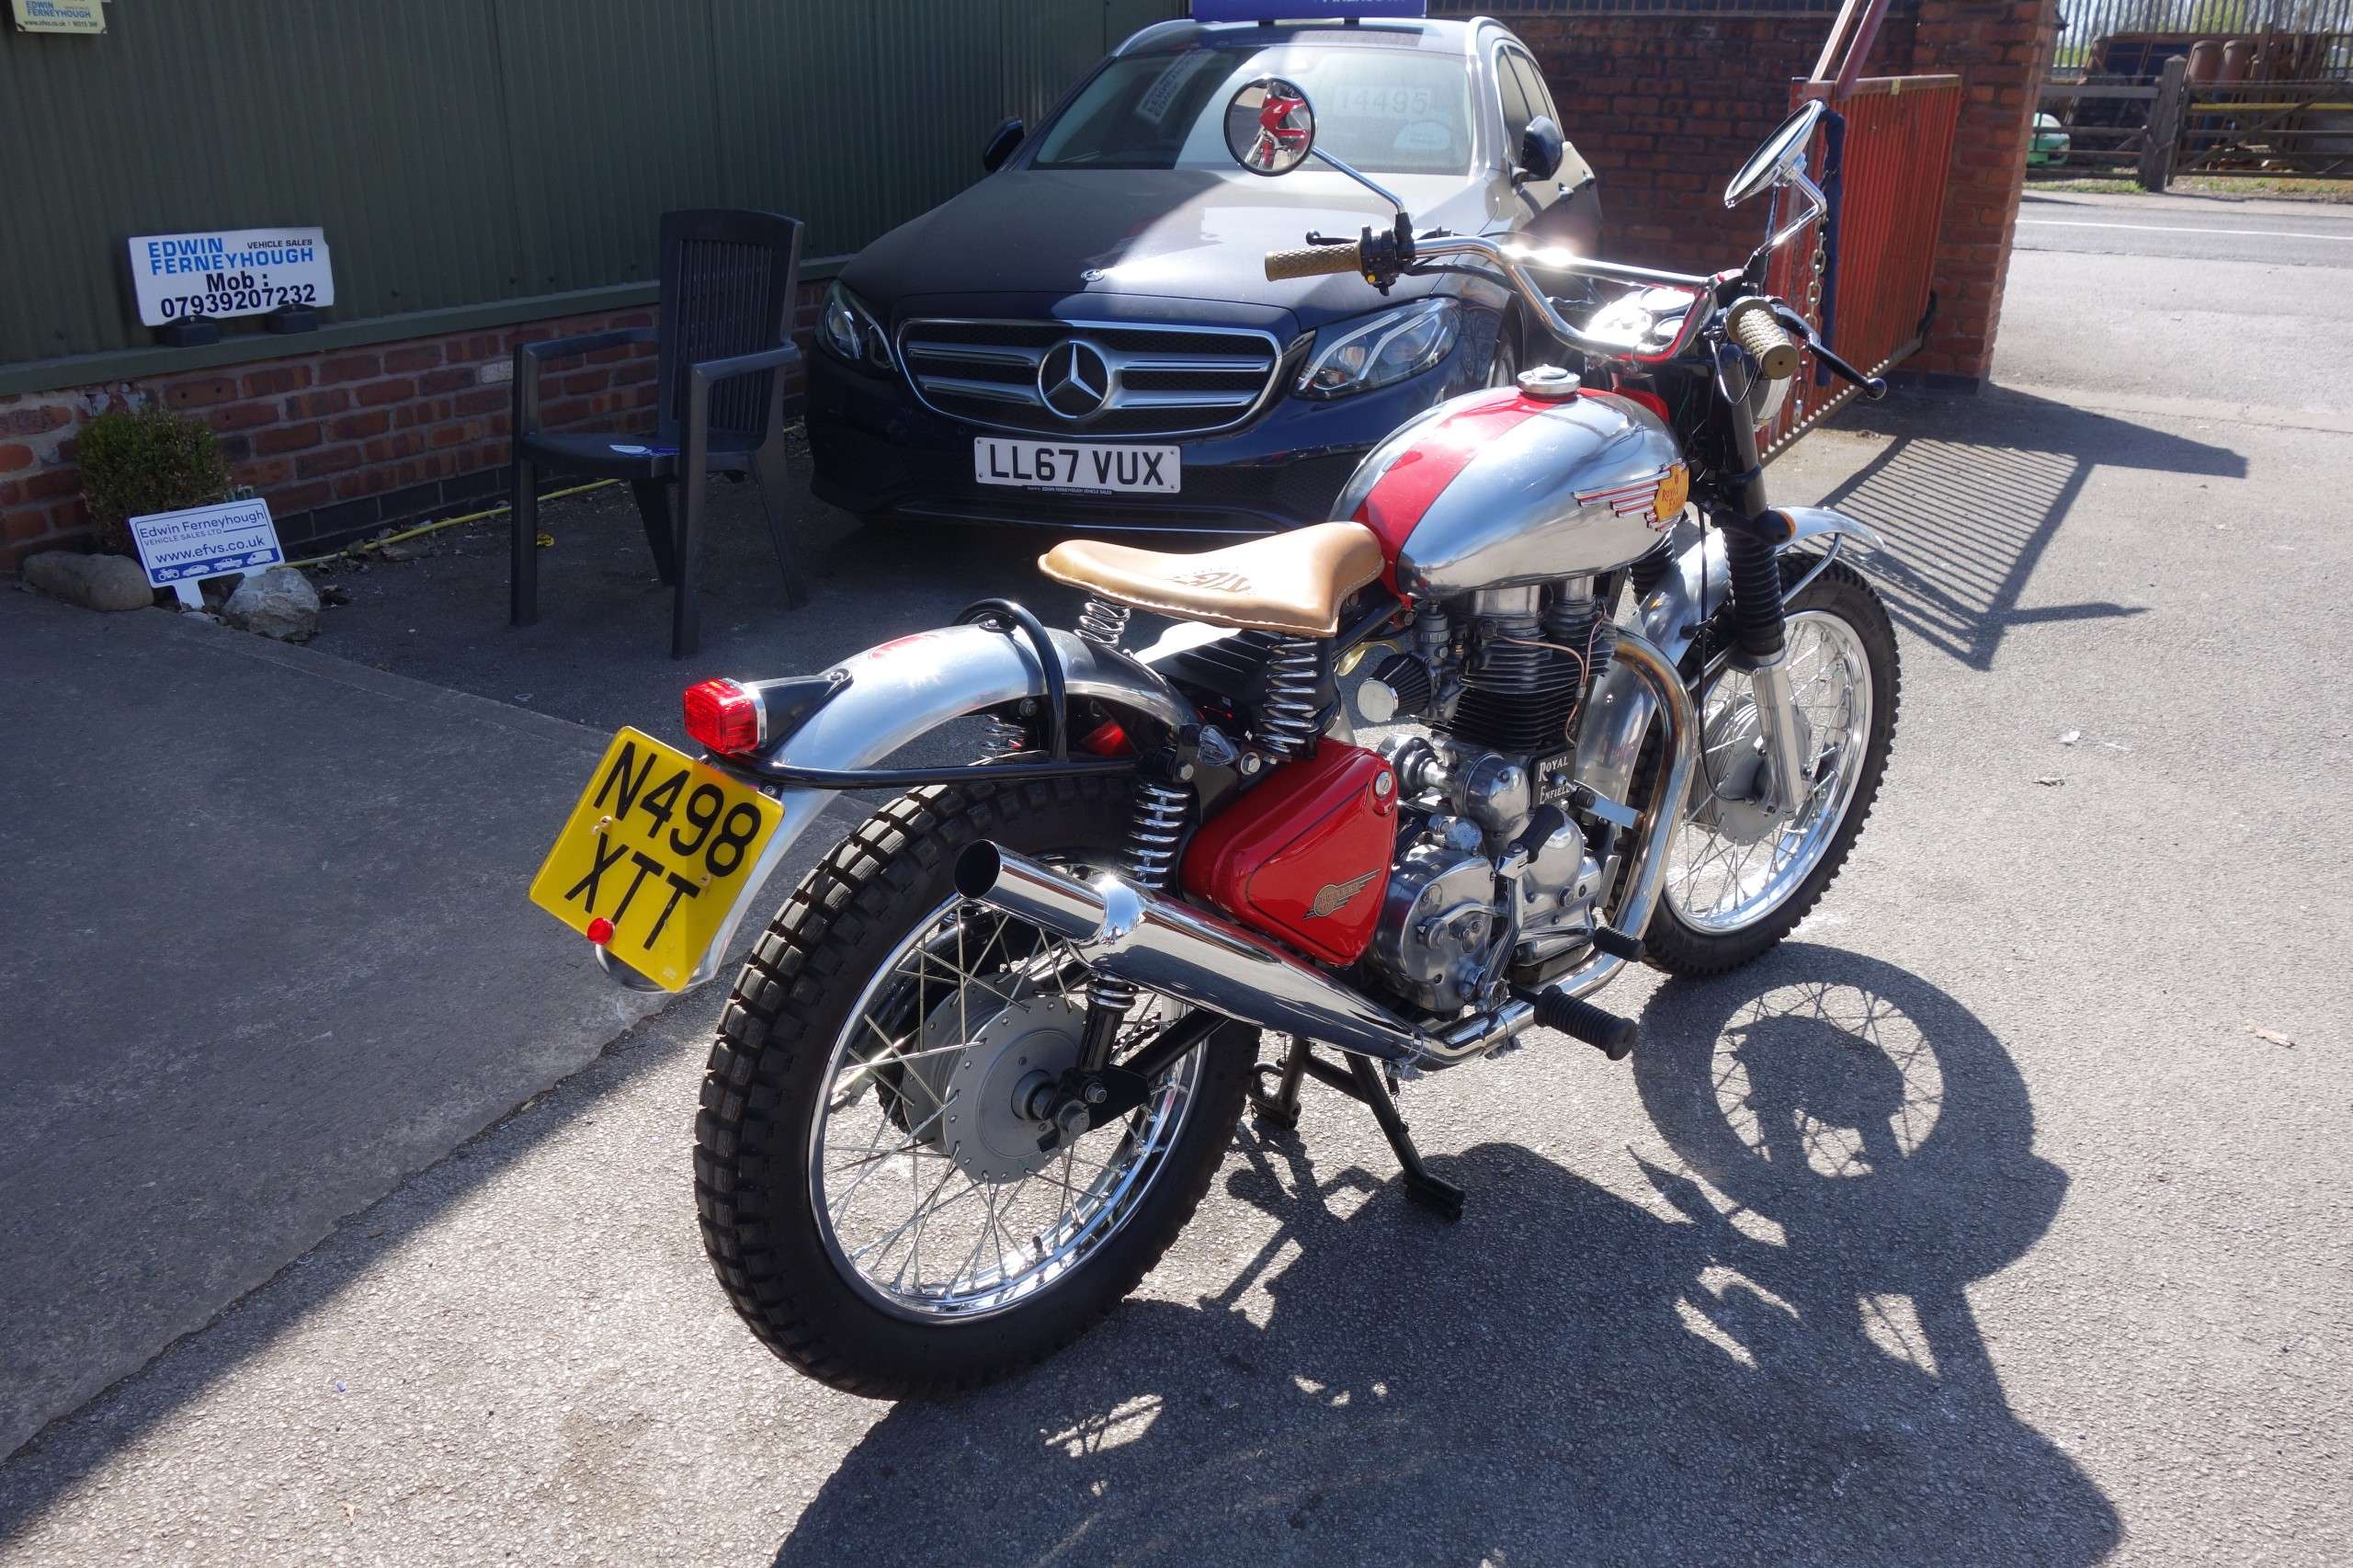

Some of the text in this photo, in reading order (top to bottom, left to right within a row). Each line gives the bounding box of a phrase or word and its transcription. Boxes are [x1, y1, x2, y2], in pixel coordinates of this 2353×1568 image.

[26, 1, 53, 9] EDWIN
[28, 8, 91, 18] FERNEYHOUGH
[147, 237, 223, 258] EDWIN
[246, 238, 313, 250] VEHICLE SALES
[150, 247, 314, 276] FERNEYHOUGH
[206, 270, 255, 293] Mob
[160, 283, 317, 318] 07939207232
[989, 444, 1164, 485] LL67 VUX
[140, 509, 265, 539] Edwin Ferneyhough
[143, 528, 222, 546] VEHICLE SALES LTD
[155, 535, 266, 563] www.efvs.co.uk
[1538, 756, 1568, 782] ROYAL
[593, 741, 762, 878] N498
[563, 832, 701, 950] XTT
